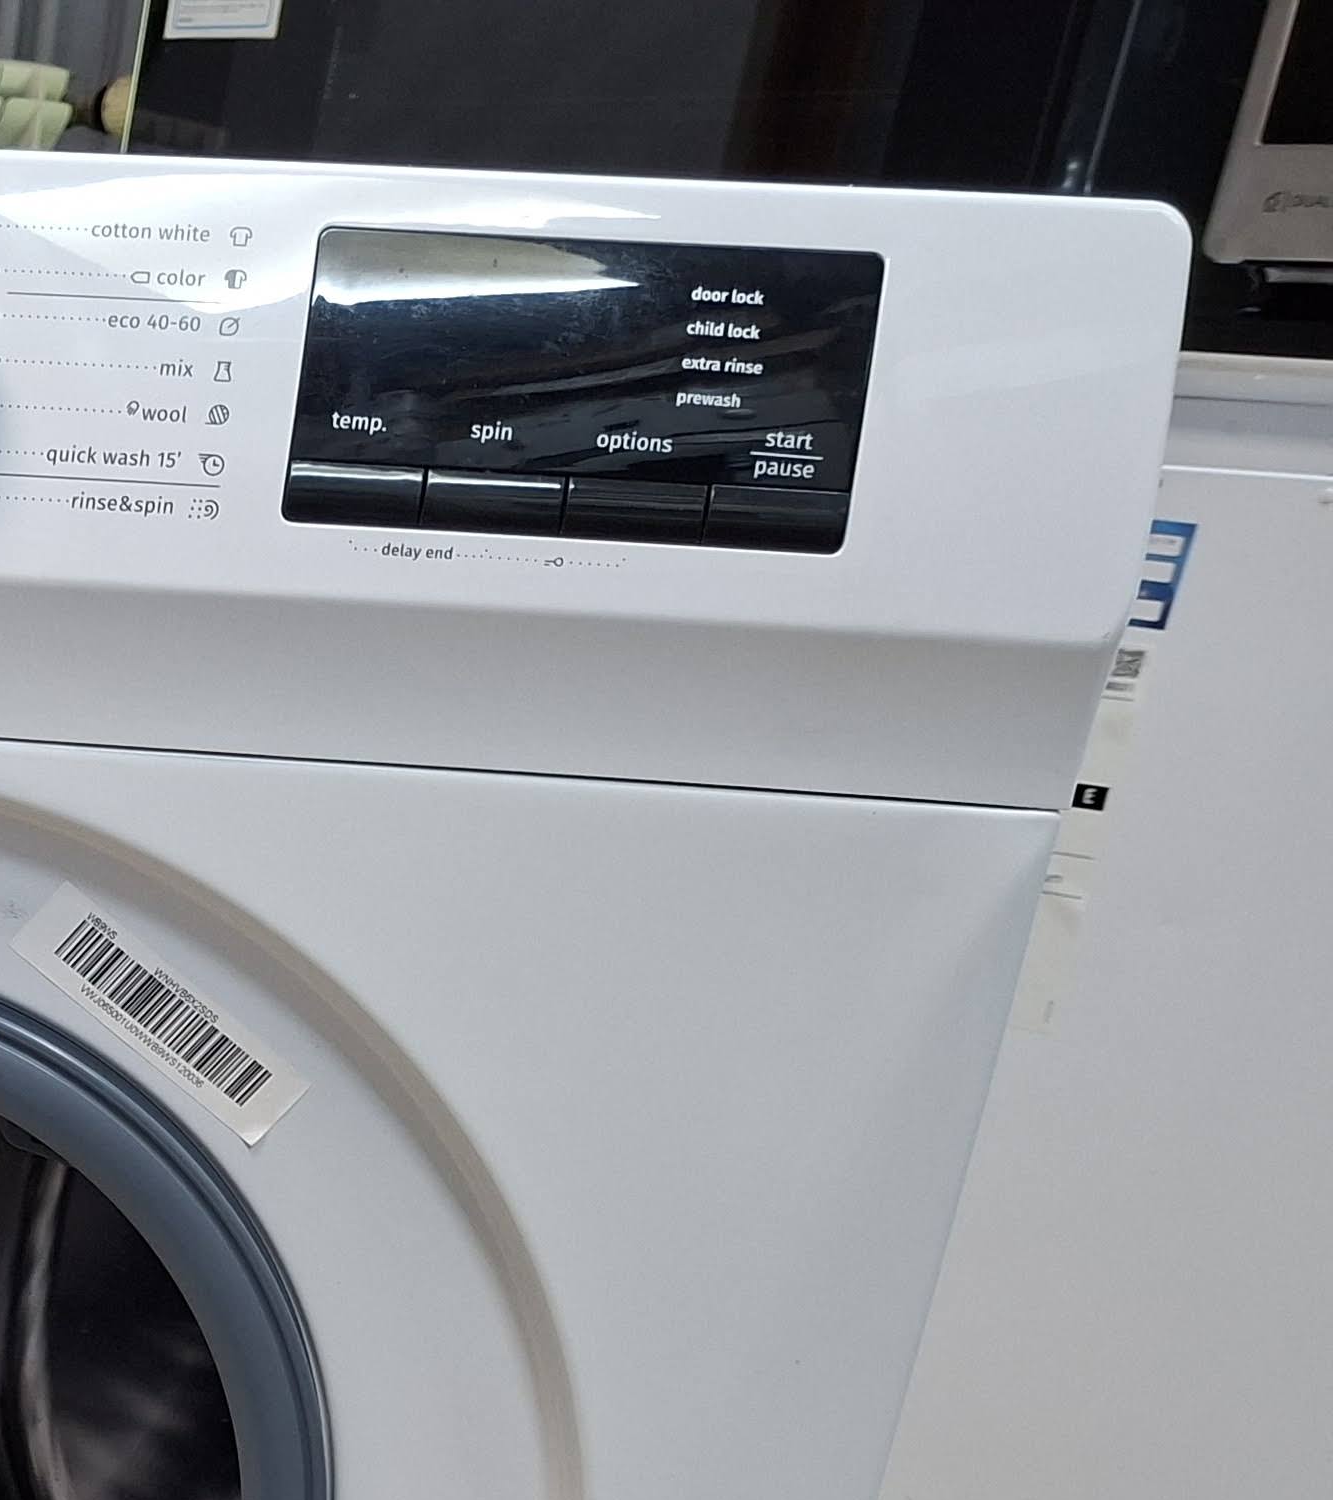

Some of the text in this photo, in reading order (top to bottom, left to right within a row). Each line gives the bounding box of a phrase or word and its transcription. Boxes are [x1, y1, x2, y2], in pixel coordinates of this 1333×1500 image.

[91, 222, 210, 242] cotton white
[157, 270, 206, 287] color
[691, 286, 764, 306] door lock
[108, 315, 202, 332] eco 40-60
[687, 320, 761, 340] child lock
[159, 360, 194, 377] mix
[682, 357, 763, 375] extra rinse
[676, 390, 742, 409] prewash
[141, 406, 187, 423] wool
[331, 412, 388, 436] temp.
[470, 422, 513, 445] spin
[596, 431, 673, 455] options
[765, 431, 813, 451] start
[46, 446, 97, 466] quick
[102, 450, 151, 467] wash
[754, 459, 815, 480] pause
[71, 492, 174, 517] rinse&spin
[381, 542, 453, 562] delay end
[1082, 788, 1097, 804] E
